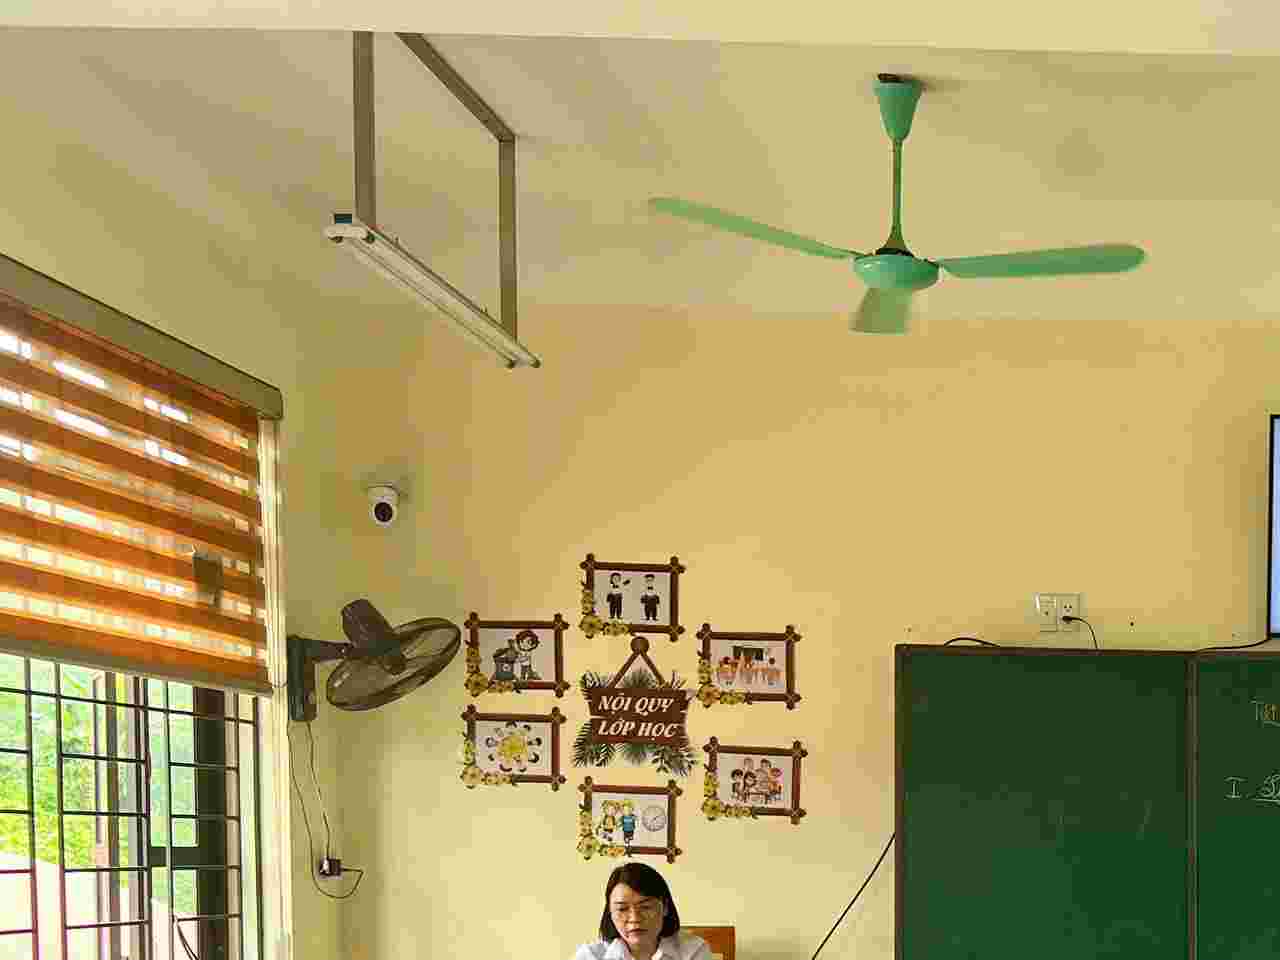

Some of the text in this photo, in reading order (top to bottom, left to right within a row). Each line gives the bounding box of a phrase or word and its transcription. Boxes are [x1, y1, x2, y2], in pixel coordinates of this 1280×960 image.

[598, 692, 674, 716] NỘI QUY
[598, 717, 680, 741] LỚP HỌC
